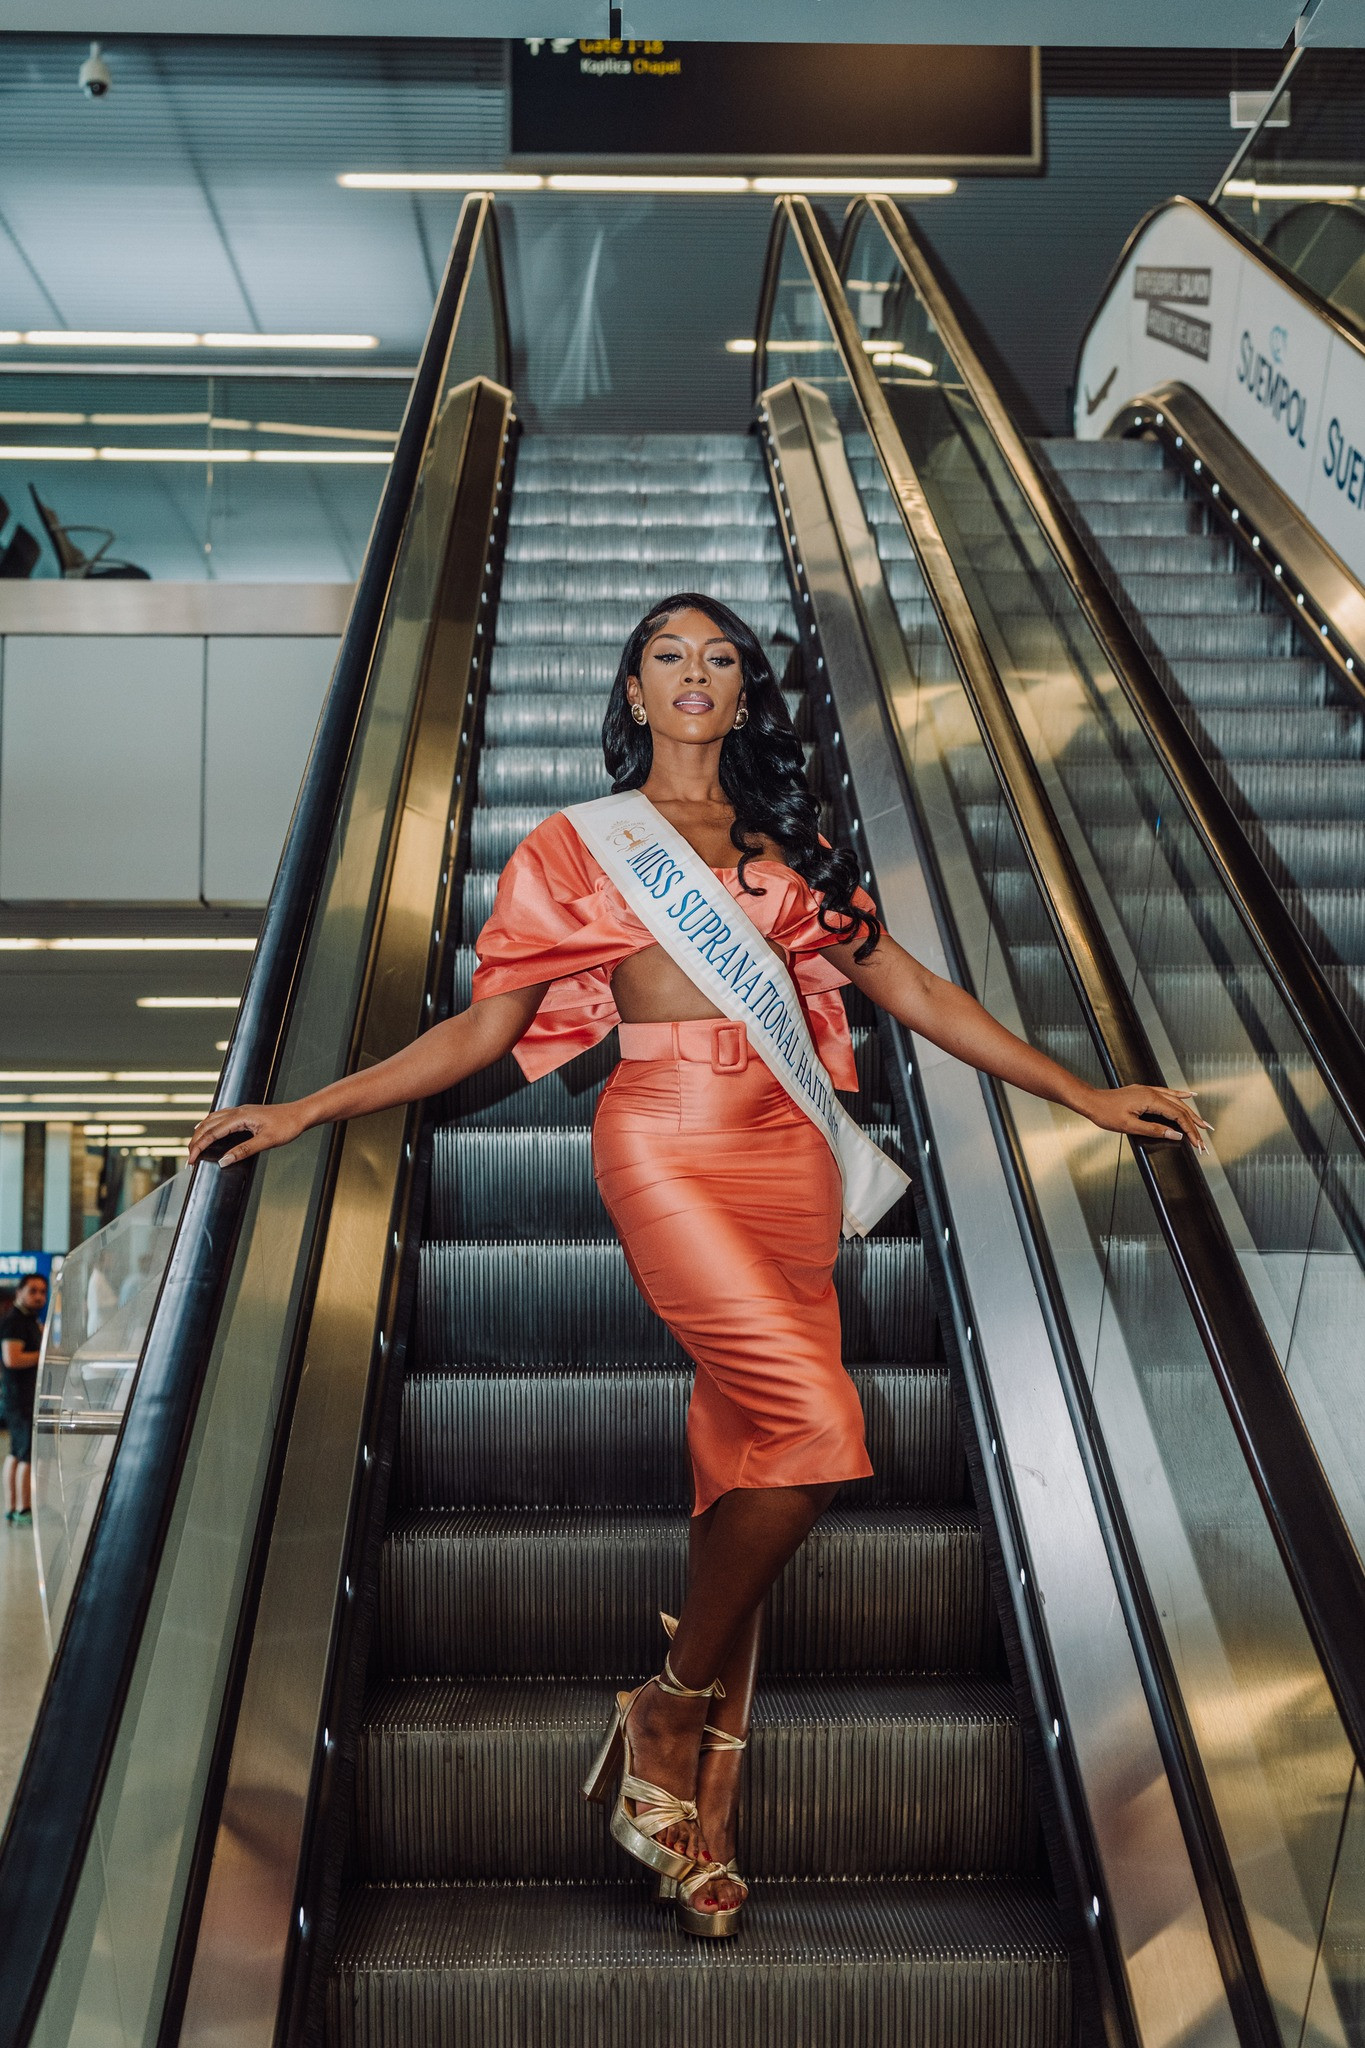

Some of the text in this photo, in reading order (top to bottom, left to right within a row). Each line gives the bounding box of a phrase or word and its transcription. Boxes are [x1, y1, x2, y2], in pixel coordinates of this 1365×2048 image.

[580, 58, 682, 76] Kaplica Chapel
[1236, 330, 1308, 449] SUEMPOL
[626, 842, 685, 899] MISS
[666, 889, 799, 1067] SUPRANATIONAL
[795, 1050, 828, 1118] HAITI
